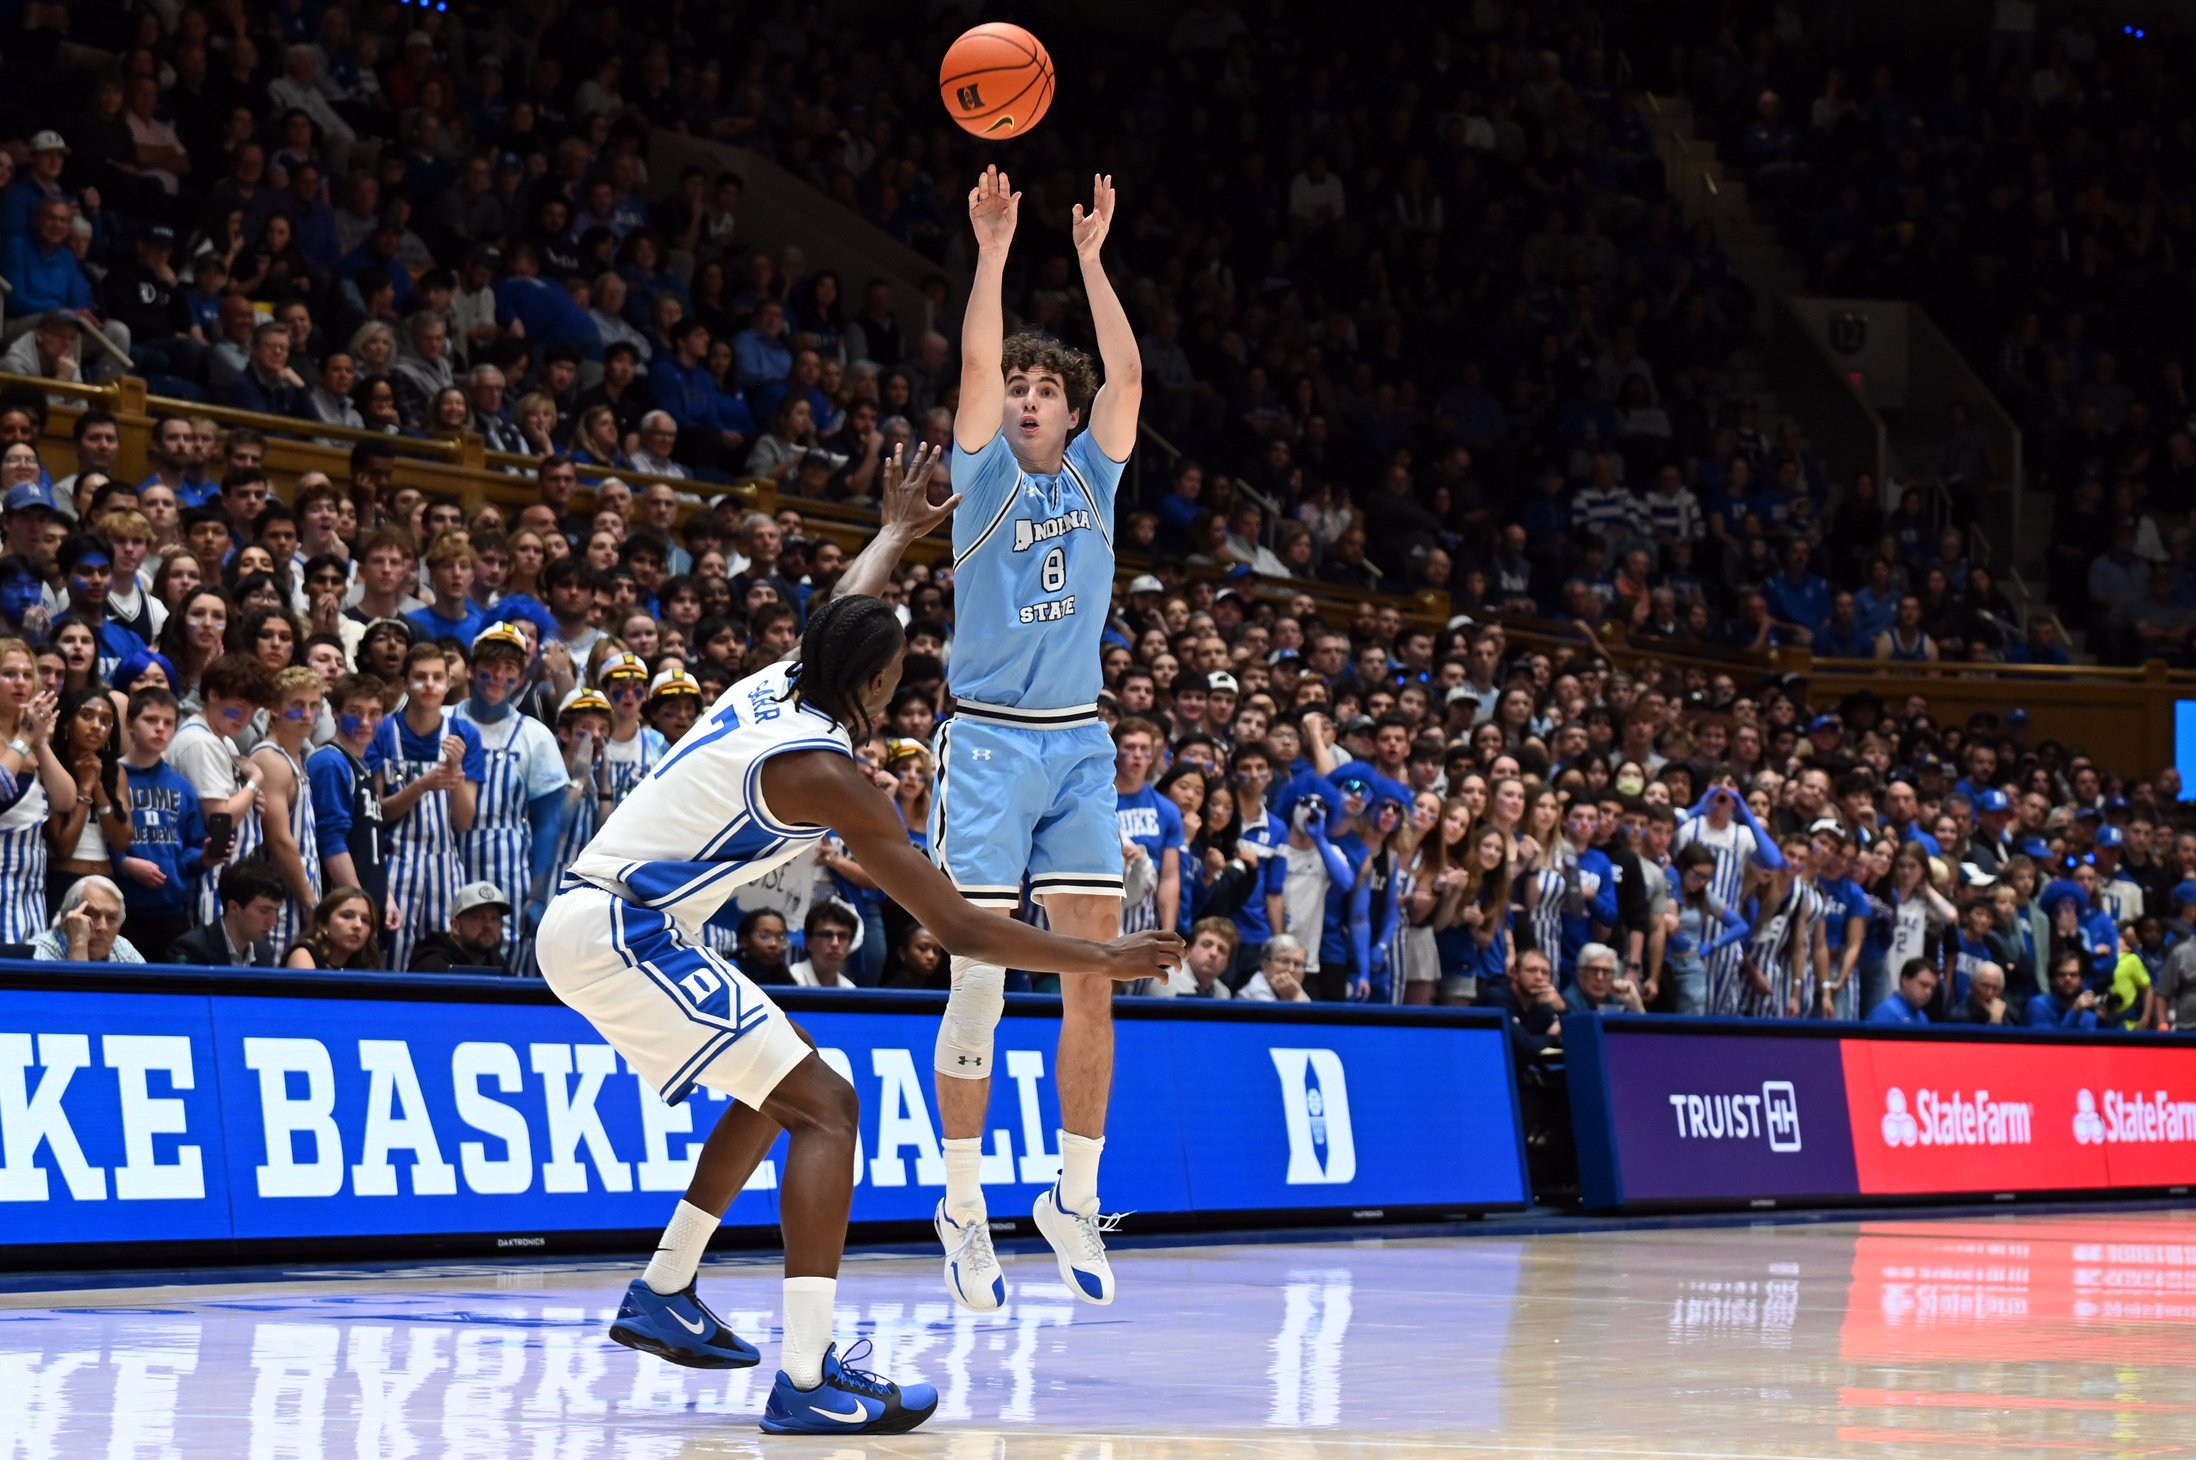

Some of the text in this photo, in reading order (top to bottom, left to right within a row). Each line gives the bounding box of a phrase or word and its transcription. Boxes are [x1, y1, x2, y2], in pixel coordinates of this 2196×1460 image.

[1041, 546, 1066, 593] 8
[747, 679, 780, 724] SARR
[654, 704, 740, 780] 7
[1117, 807, 1160, 838] UKE
[1669, 1094, 1761, 1139] TRUIST
